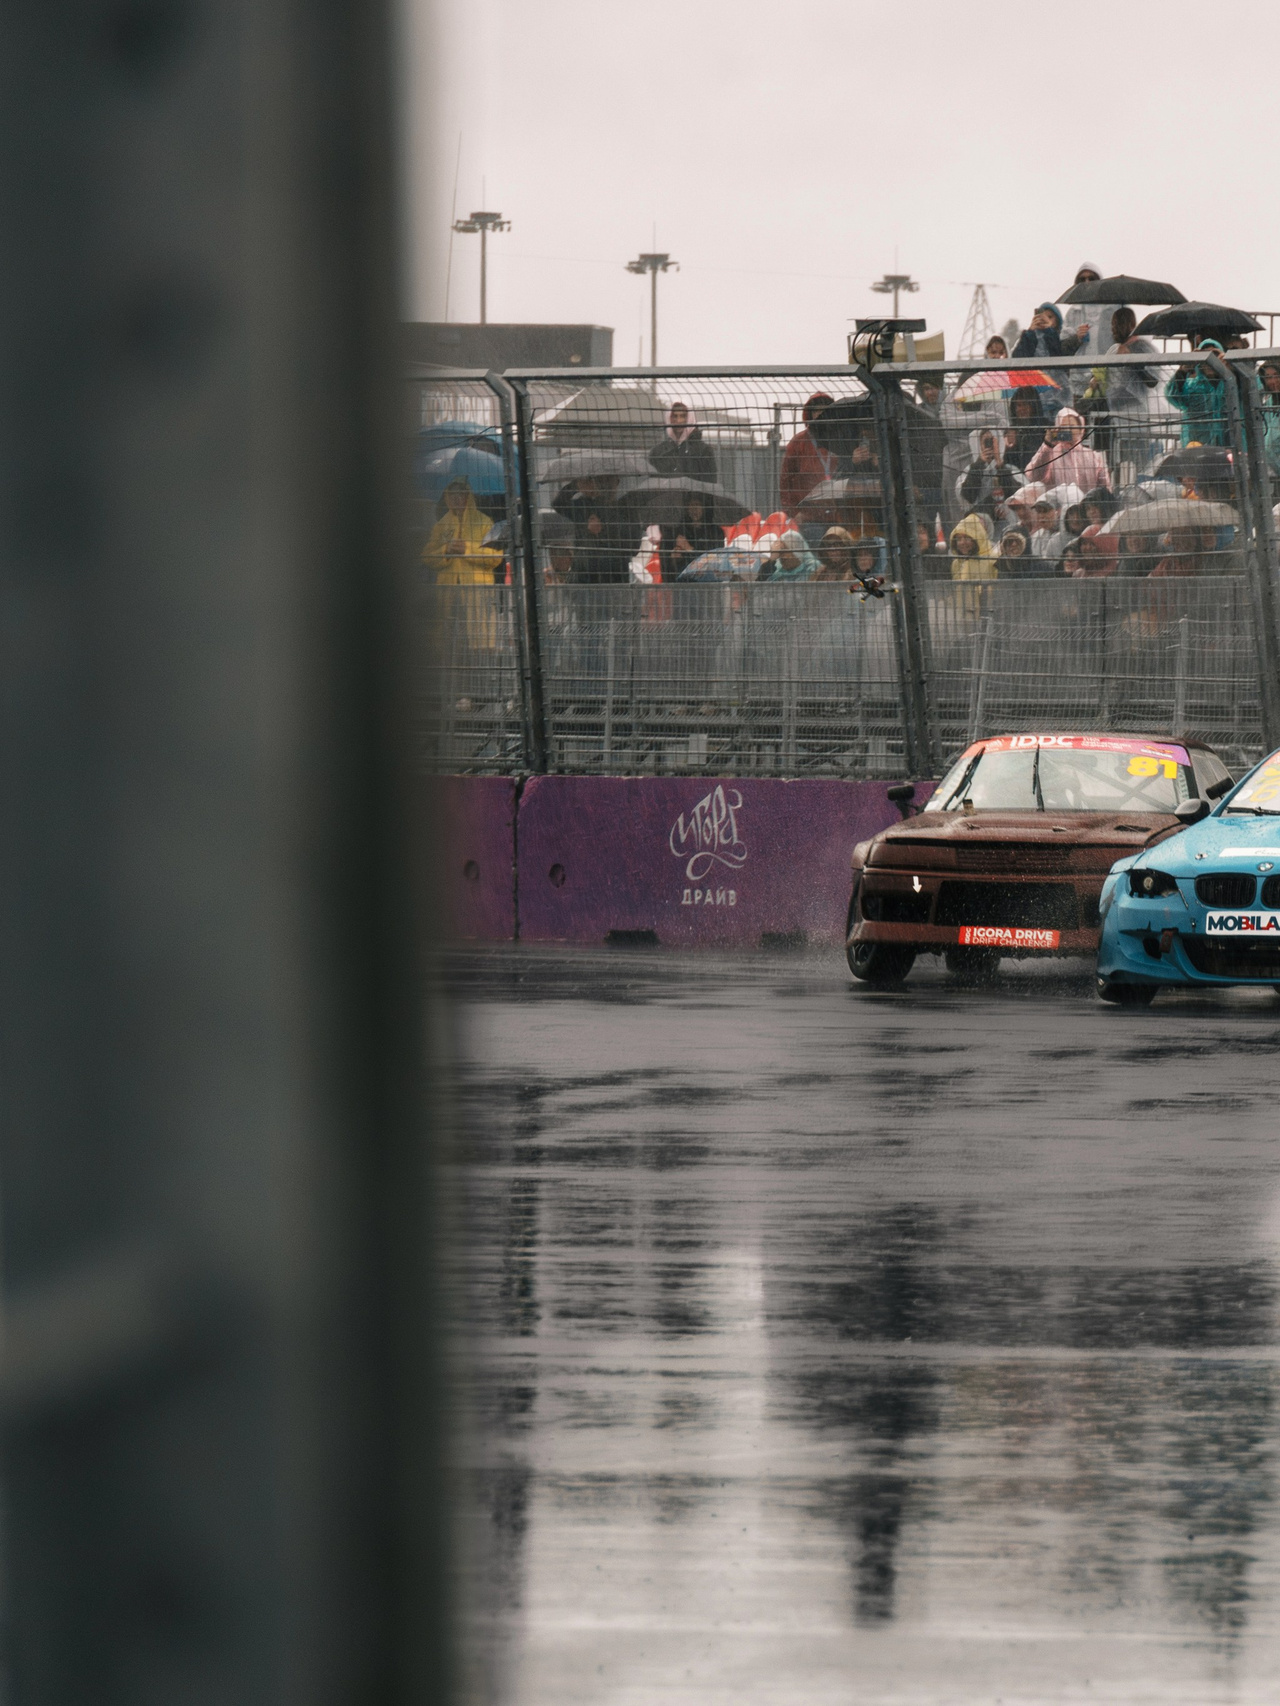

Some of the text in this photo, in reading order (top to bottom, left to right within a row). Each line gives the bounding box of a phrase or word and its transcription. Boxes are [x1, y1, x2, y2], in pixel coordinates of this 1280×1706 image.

[1009, 736, 1074, 747] IDDC
[1126, 756, 1178, 779] 81
[681, 886, 737, 906] ДРАЙВ
[973, 927, 1054, 940] IGORA DRIVE
[972, 937, 1053, 948] DRIFT CHALLENGE
